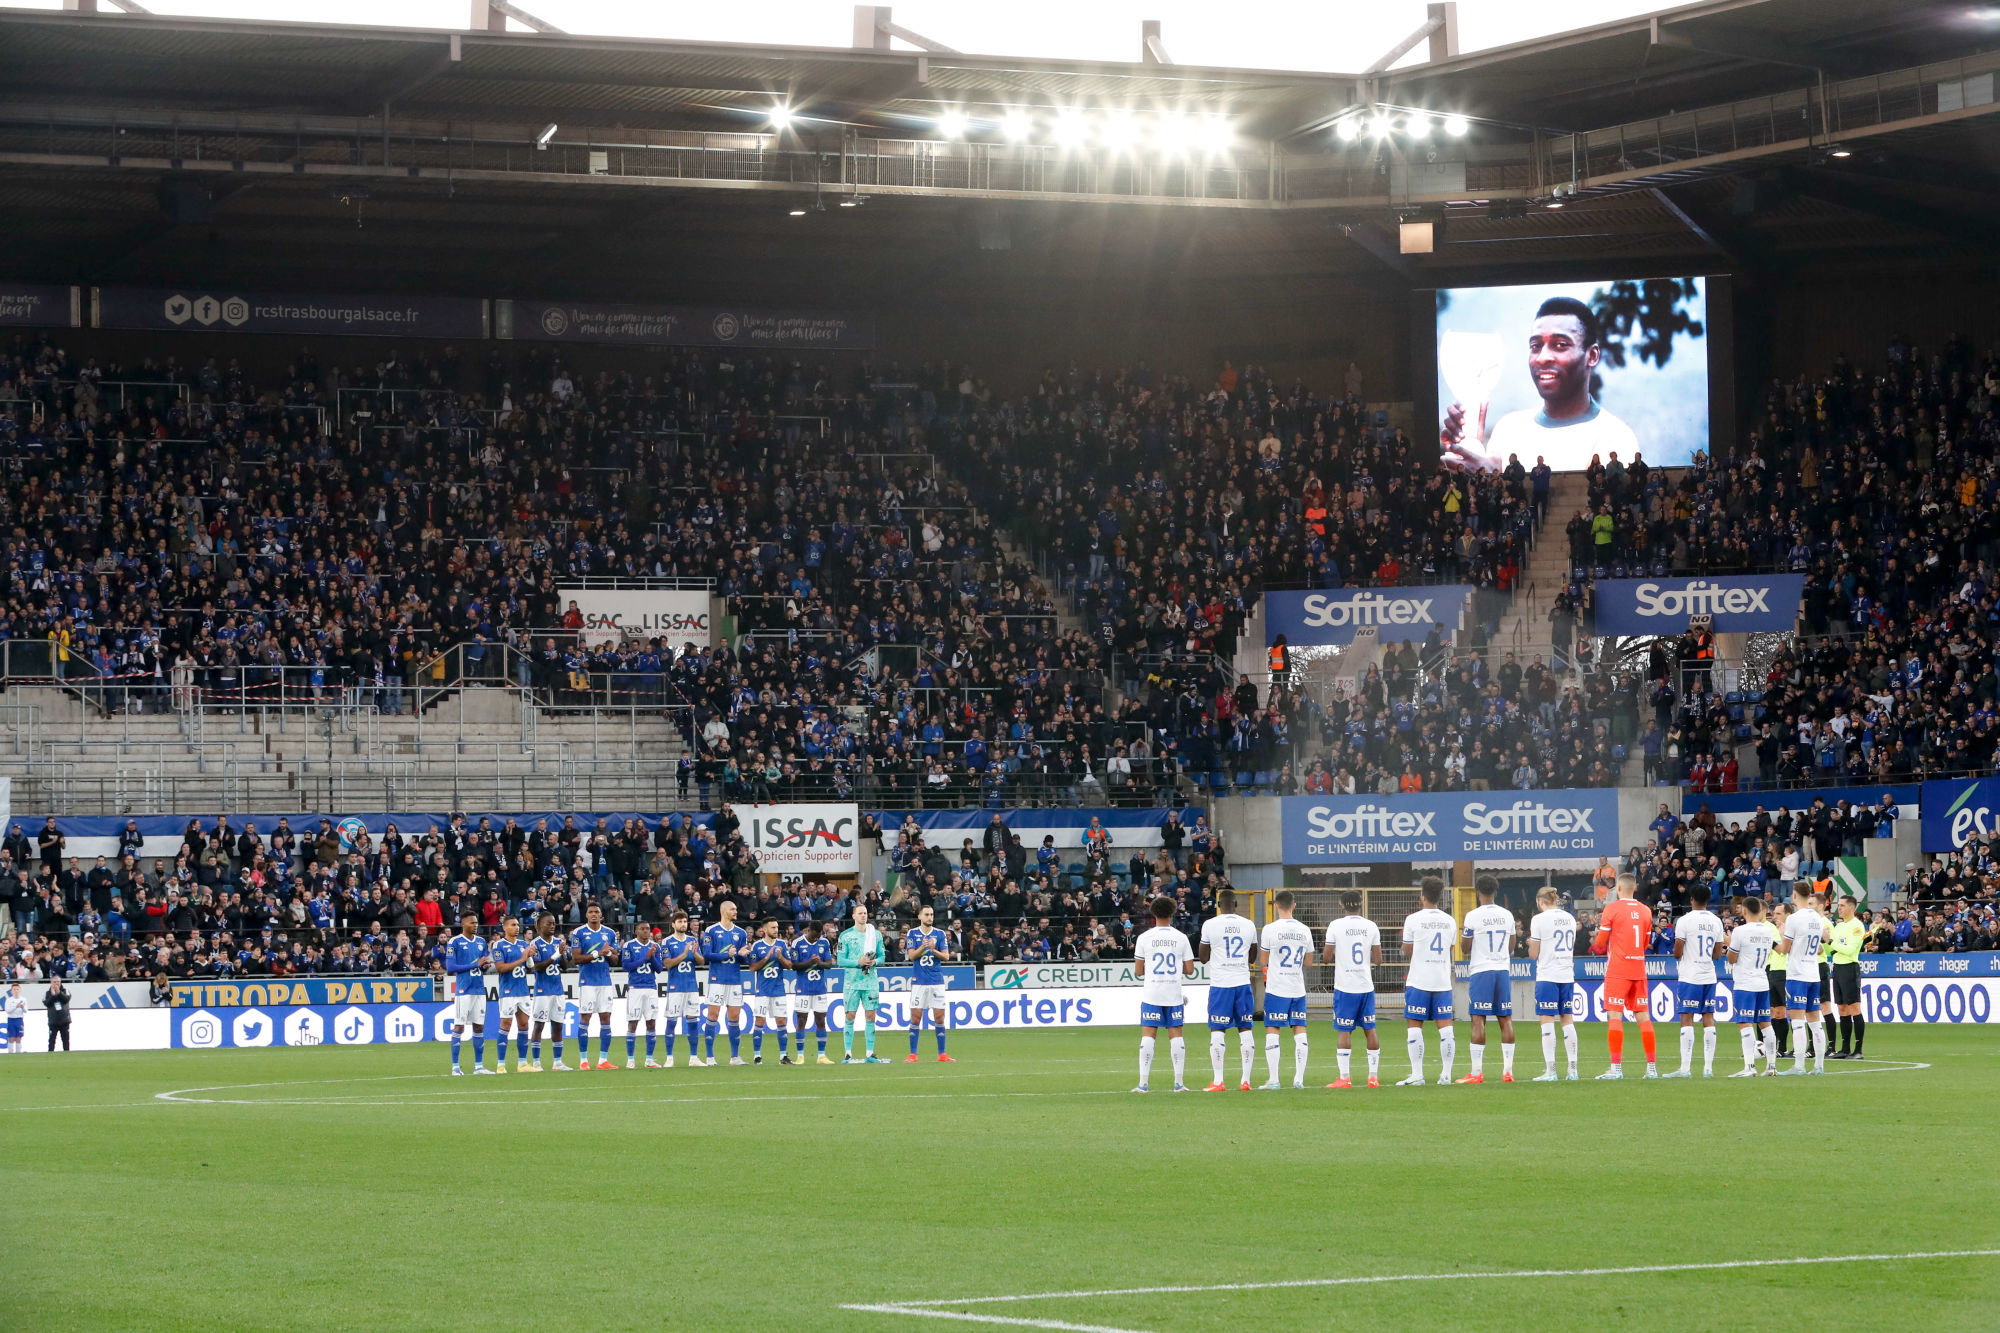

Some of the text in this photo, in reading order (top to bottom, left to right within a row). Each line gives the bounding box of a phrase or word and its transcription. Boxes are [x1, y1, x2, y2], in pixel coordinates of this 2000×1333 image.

[255, 306, 419, 323] rcstrasbourgalsace.fr
[1304, 592, 1434, 626] Sofitex
[1635, 580, 1770, 616] Sofitex
[586, 614, 622, 630] SAC
[644, 614, 708, 630] LISSAC
[1306, 804, 1436, 838] Sofitex
[1463, 801, 1594, 834] Sofitex
[753, 818, 852, 848] ISSAC
[1308, 841, 1436, 854] DE L'INTÉRIM AU CDI
[1464, 838, 1594, 851] DE L'INTÉRIM AU CDI
[754, 850, 853, 864] Opticien Supporter
[1223, 936, 1244, 958] 12
[1430, 932, 1443, 954] 4
[1487, 930, 1506, 952] 17
[1554, 929, 1574, 951] 20
[1633, 925, 1640, 948] 1
[1697, 935, 1714, 957] 18
[1805, 935, 1819, 956] 19
[1152, 953, 1177, 975] 29
[1279, 946, 1303, 968] 24
[1352, 942, 1363, 965] 6
[1756, 948, 1767, 968] 11
[1037, 965, 1113, 982] CRÉDIT
[1510, 964, 1531, 976] AMAX
[1860, 960, 1878, 974] ager
[325, 982, 420, 1004] PARK
[1862, 984, 1990, 1023] 180000
[875, 994, 1093, 1028] supporters
